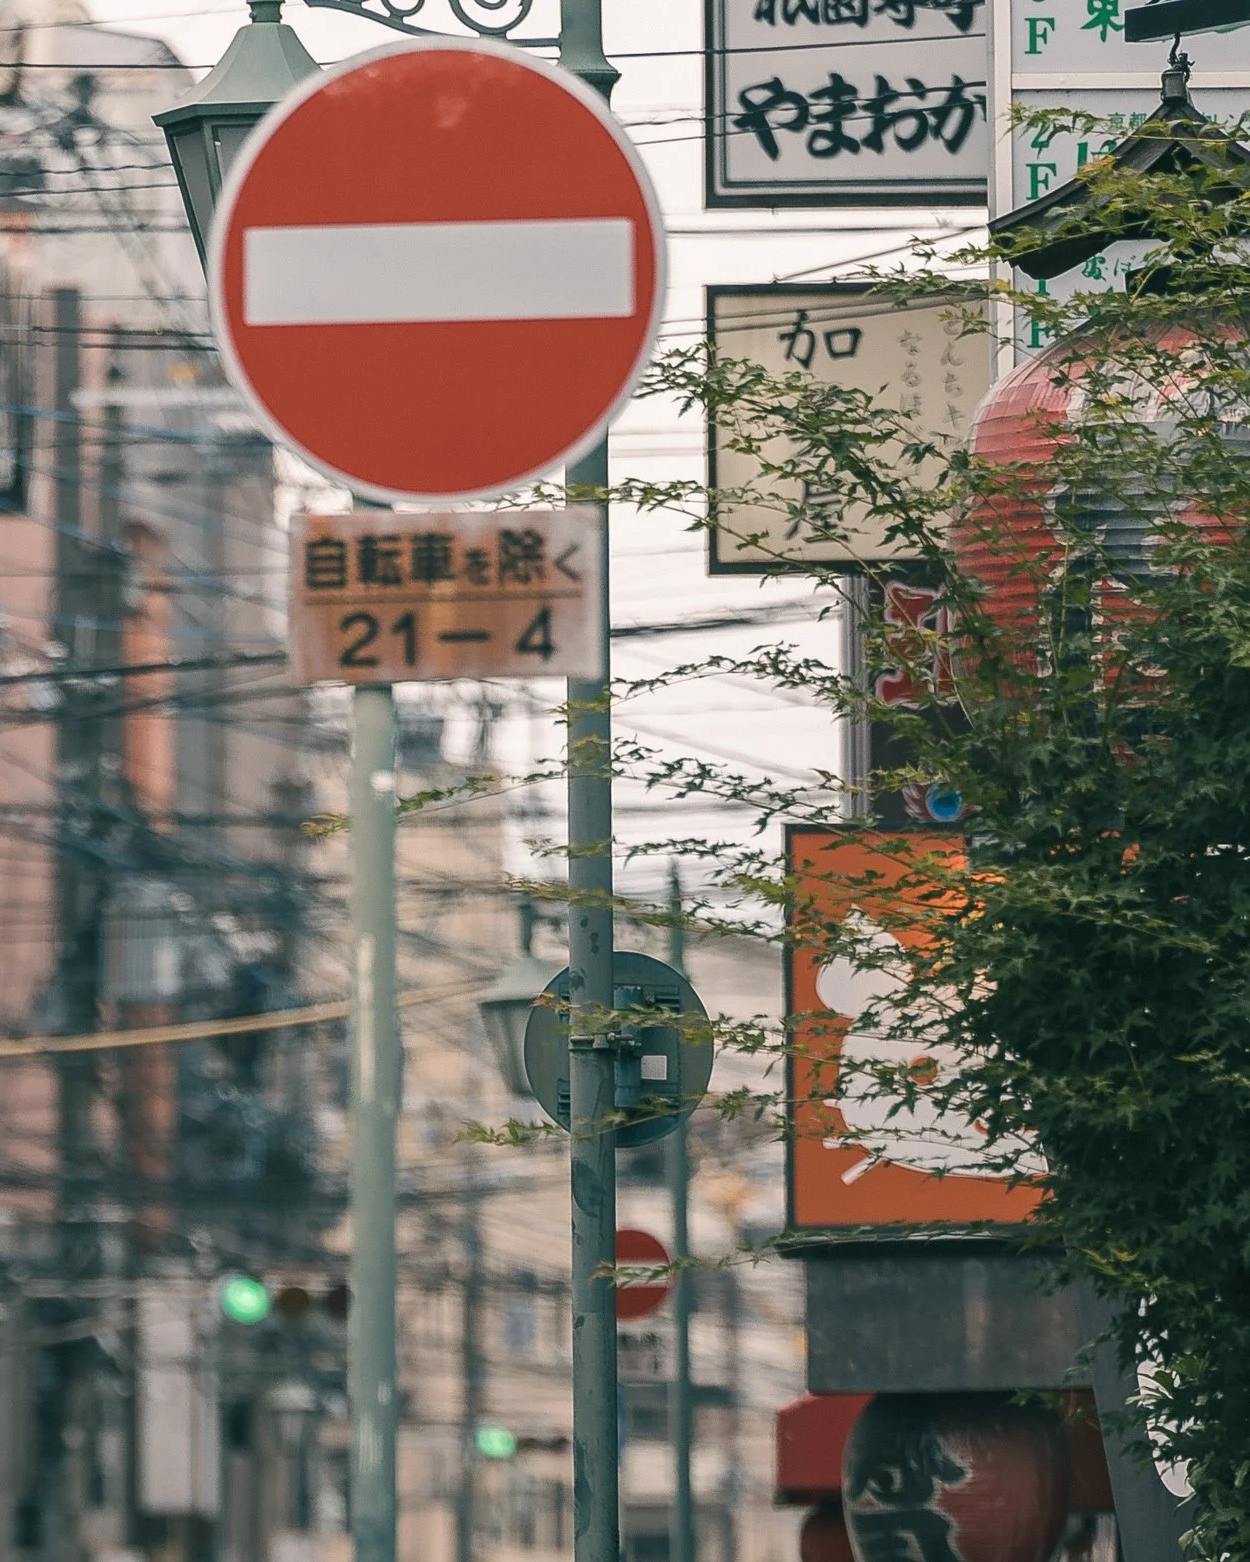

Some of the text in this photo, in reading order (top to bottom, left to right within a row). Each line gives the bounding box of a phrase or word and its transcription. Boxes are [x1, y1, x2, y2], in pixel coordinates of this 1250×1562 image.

[733, 72, 986, 162] やまおか
[305, 527, 582, 590] 自転車を除く
